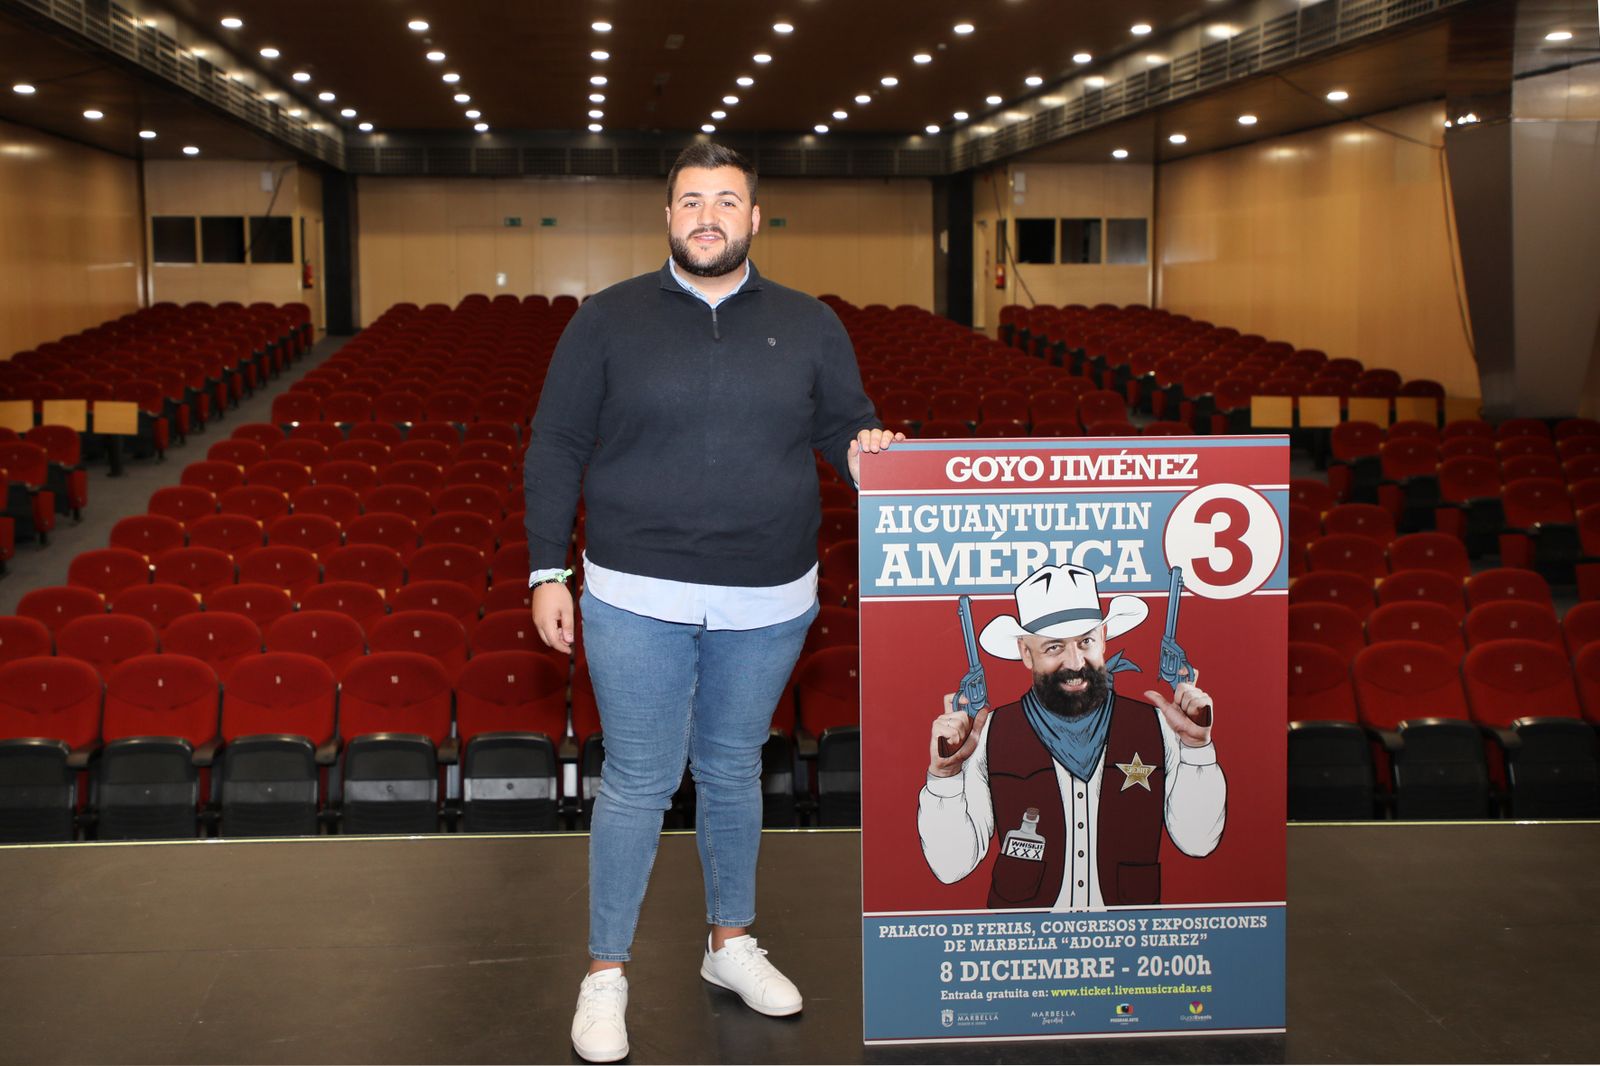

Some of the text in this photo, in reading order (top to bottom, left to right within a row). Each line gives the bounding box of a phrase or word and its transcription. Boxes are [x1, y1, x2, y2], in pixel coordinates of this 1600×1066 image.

[945, 449, 1198, 483] GOYO JIMÉNEZ
[875, 502, 1152, 533] AIGUANTULIVIN
[1191, 497, 1253, 586] 3
[875, 531, 1151, 587] AMÉRICA
[879, 915, 1267, 938] PALACIO DE FERIAS, CONGRESOS Y EXPOSICIONES
[944, 940, 966, 952] DE
[970, 937, 1057, 952] MARBELLA
[940, 961, 953, 983] 8
[960, 957, 1115, 982] DICIEMBRE
[1137, 954, 1212, 977] 20:00h
[940, 984, 1213, 1001] Entrada gratuita en: www.ticket.livemusicradar.es
[957, 1014, 999, 1022] MARBELLA
[1031, 1010, 1076, 1018] MARBELLA
